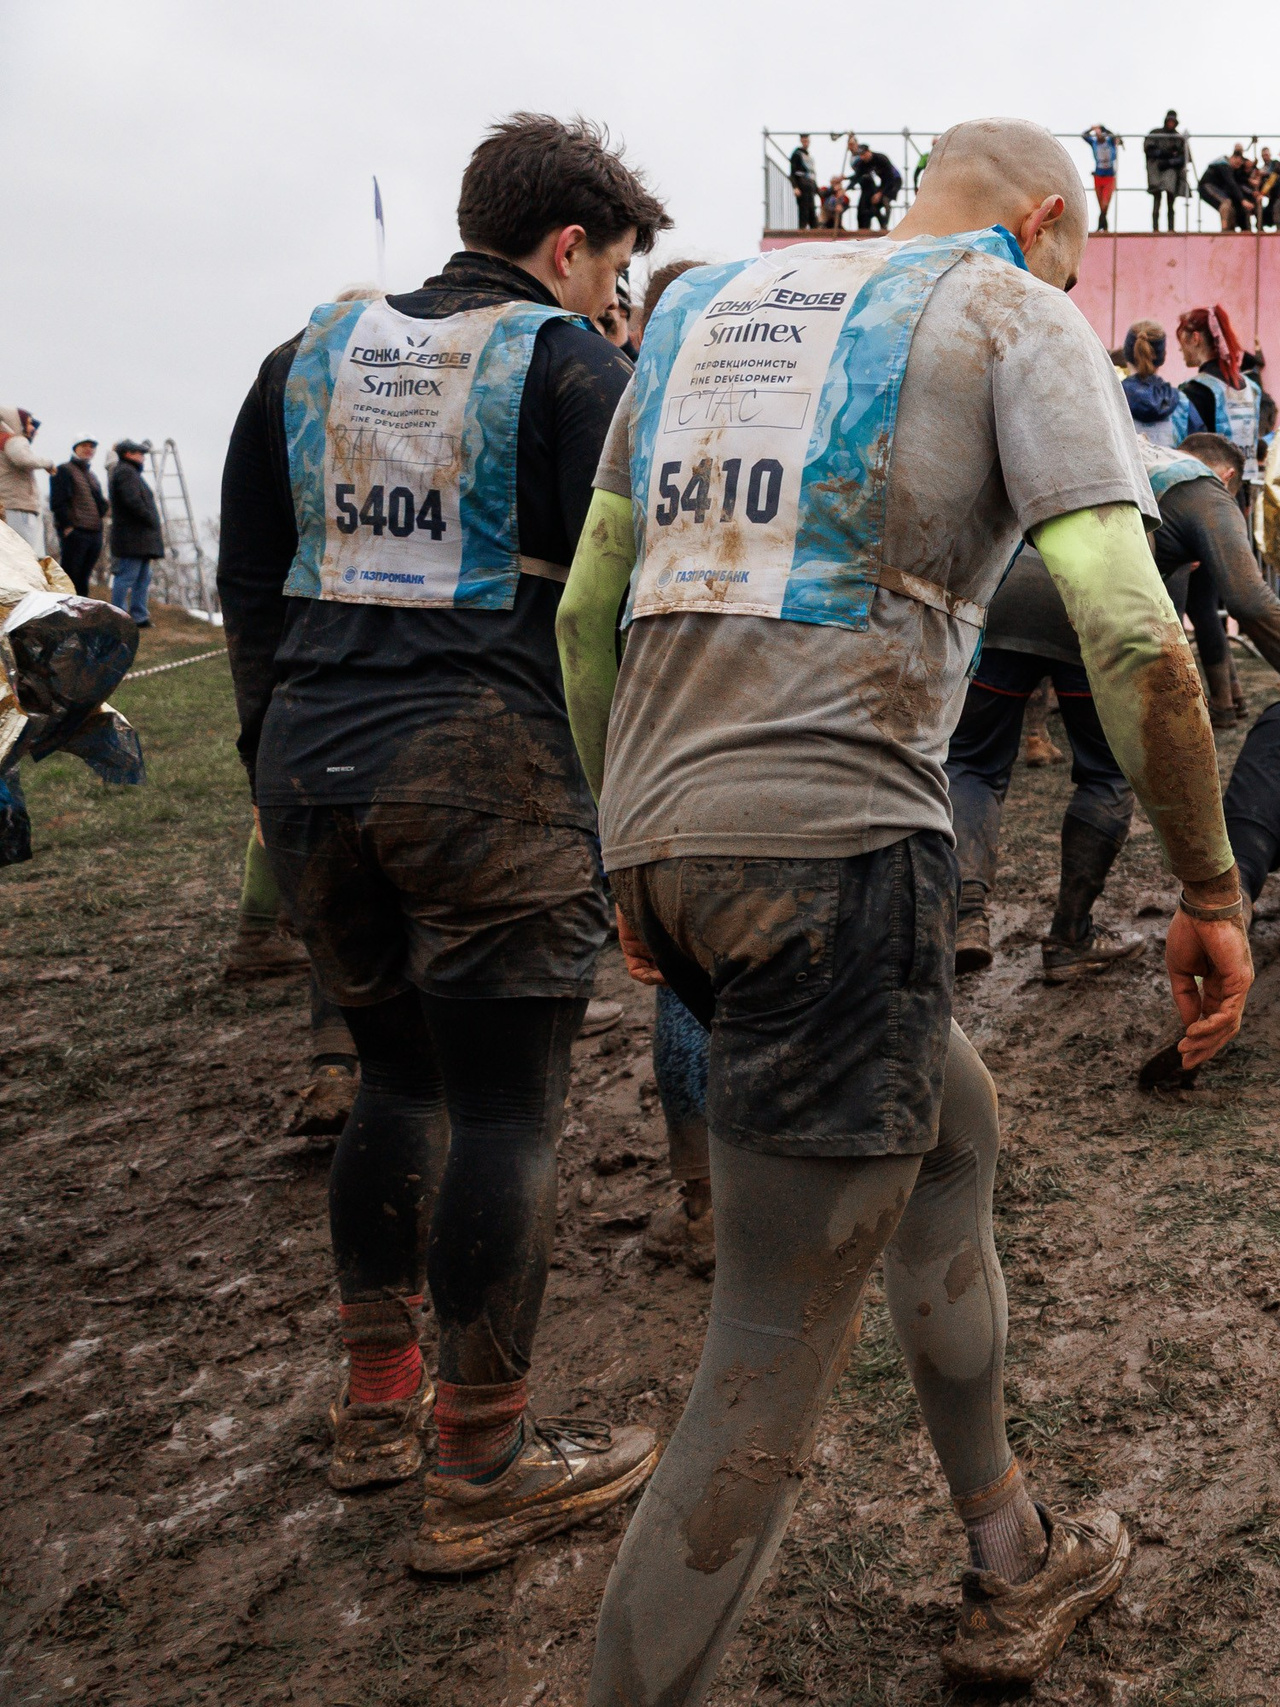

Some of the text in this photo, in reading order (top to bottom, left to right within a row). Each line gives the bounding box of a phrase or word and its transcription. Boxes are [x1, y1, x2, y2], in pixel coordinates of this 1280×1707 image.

[764, 288, 848, 306] ГЕРОЕВ
[704, 317, 807, 347] Sminex
[352, 347, 472, 365] ГОНКА ГЕРОЕВ
[694, 359, 798, 371] ПЕРФЕКЦИОНИСТЫ
[360, 375, 443, 397] Sminex
[690, 374, 793, 386] FINE DEVELOPMENT
[352, 403, 440, 418] ПЕРФЕКЦИОНИСТЫ
[350, 415, 438, 430] FINE DEVELOPMENT
[656, 458, 784, 526] 5410
[336, 484, 446, 541] 5404
[359, 570, 425, 585] ГАЗПРОМБАНК
